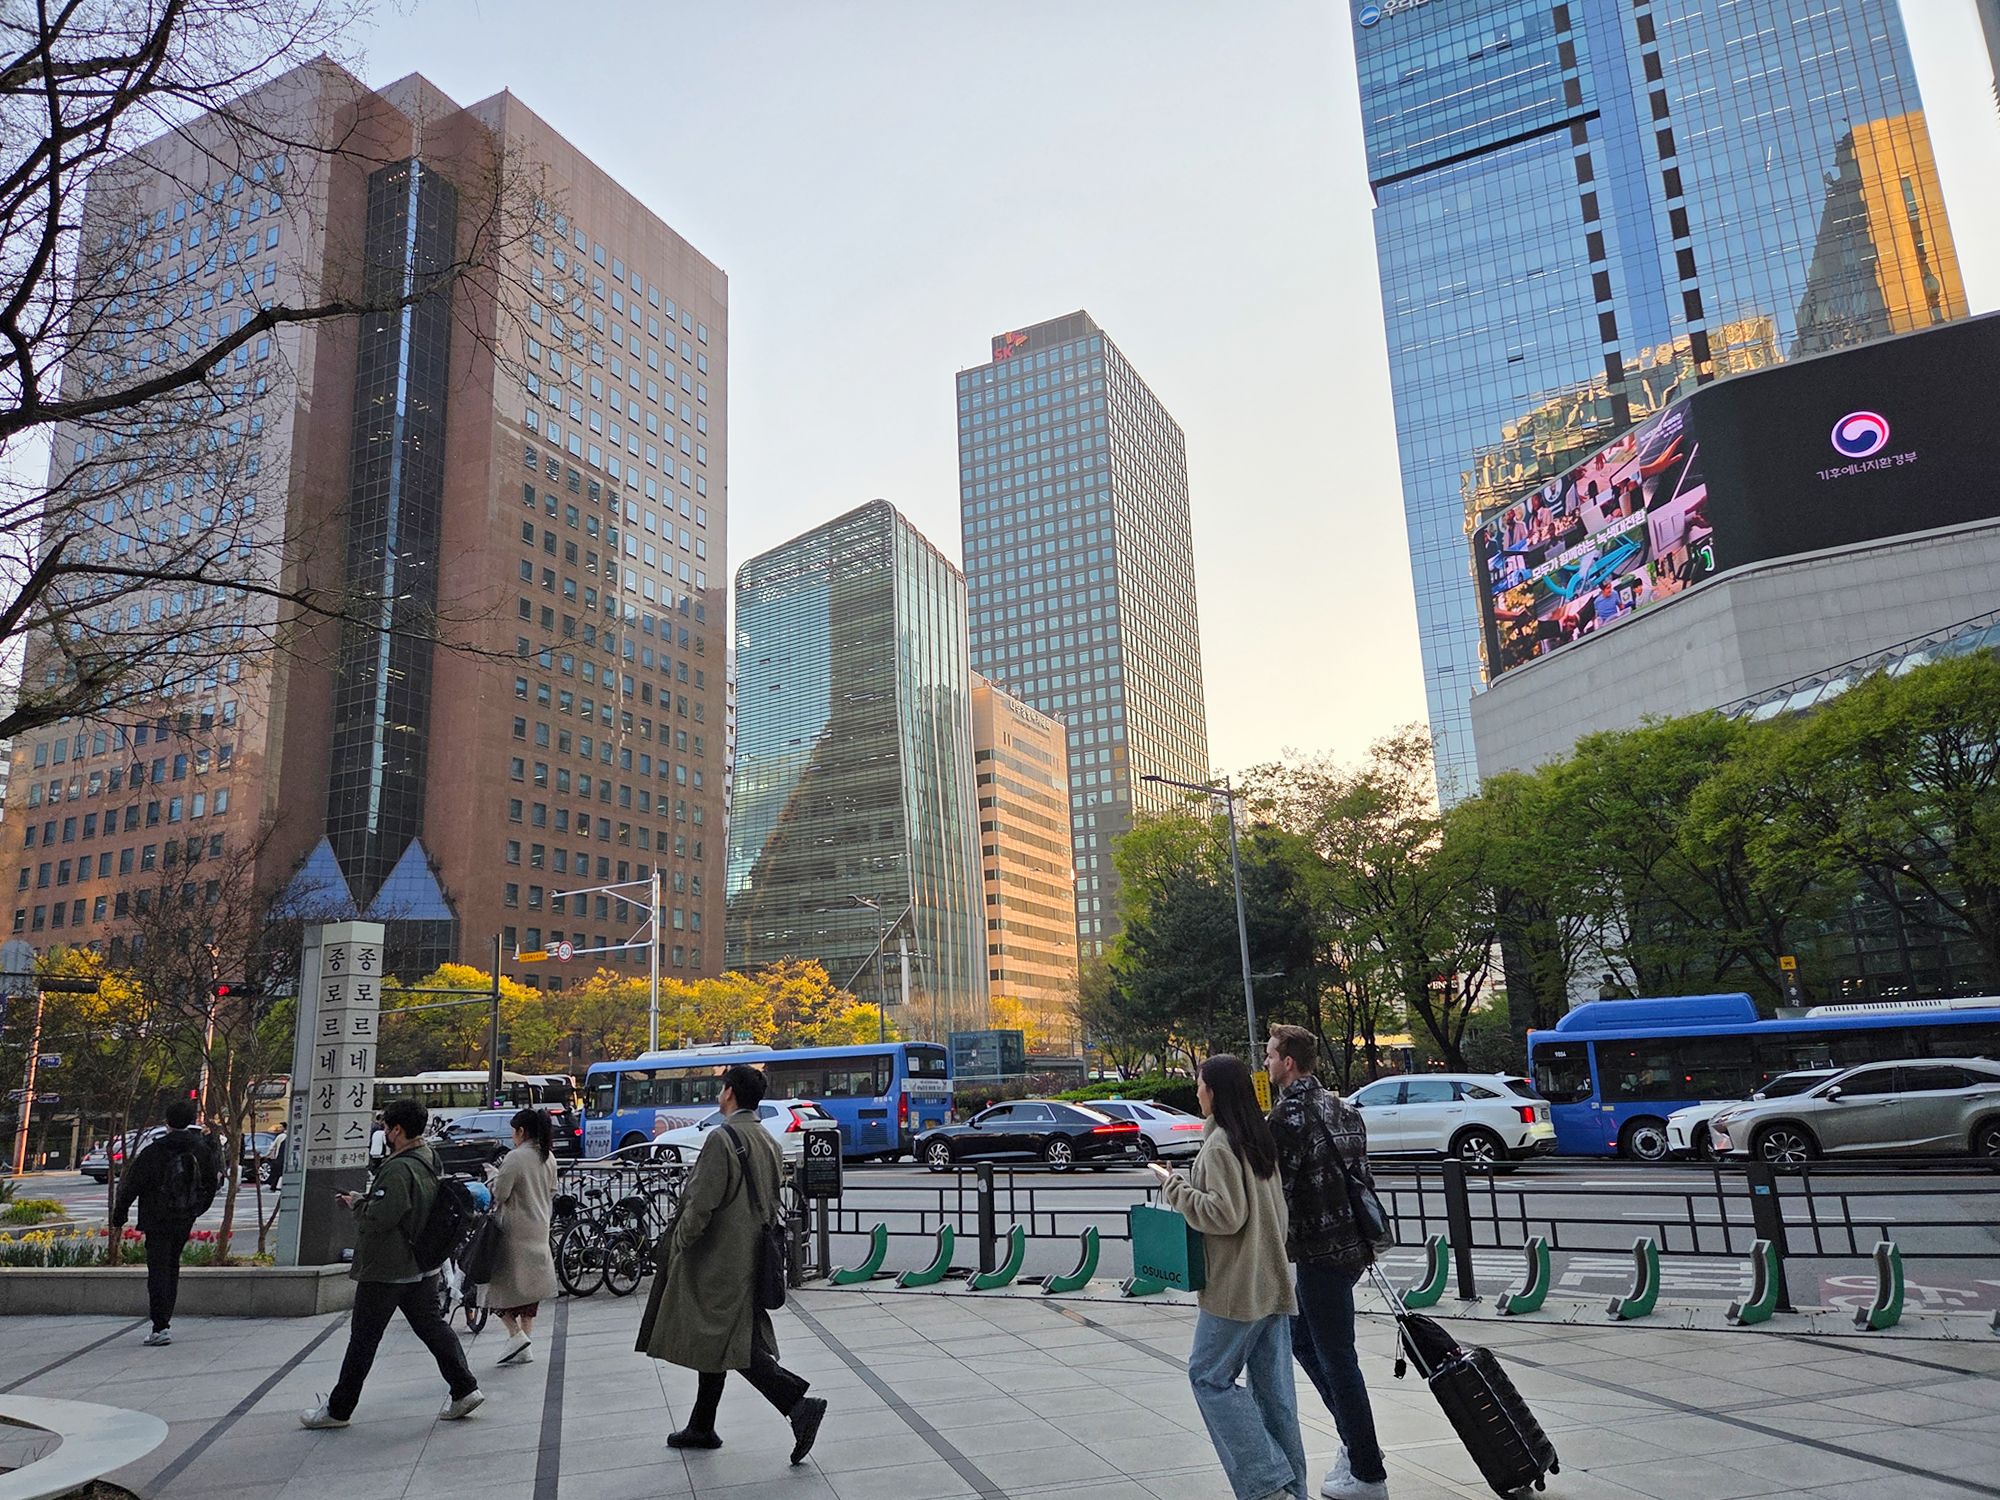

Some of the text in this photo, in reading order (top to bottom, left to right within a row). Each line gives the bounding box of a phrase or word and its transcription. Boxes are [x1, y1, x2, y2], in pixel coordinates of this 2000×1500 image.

[994, 345, 1013, 360] SK
[1816, 452, 1918, 480] 기후에너지환경부
[1531, 554, 1560, 581] 모두가
[1558, 539, 1597, 567] 함께하는
[1596, 508, 1648, 544] 녹색대전환
[560, 945, 570, 958] 50
[313, 947, 346, 1142] 종로르네상스
[343, 947, 378, 1141] 종로르네상스
[809, 1134, 816, 1144] P
[310, 1153, 334, 1166] 종각역
[340, 1152, 367, 1165] 종각역
[1142, 1265, 1182, 1283] OSULLOC
